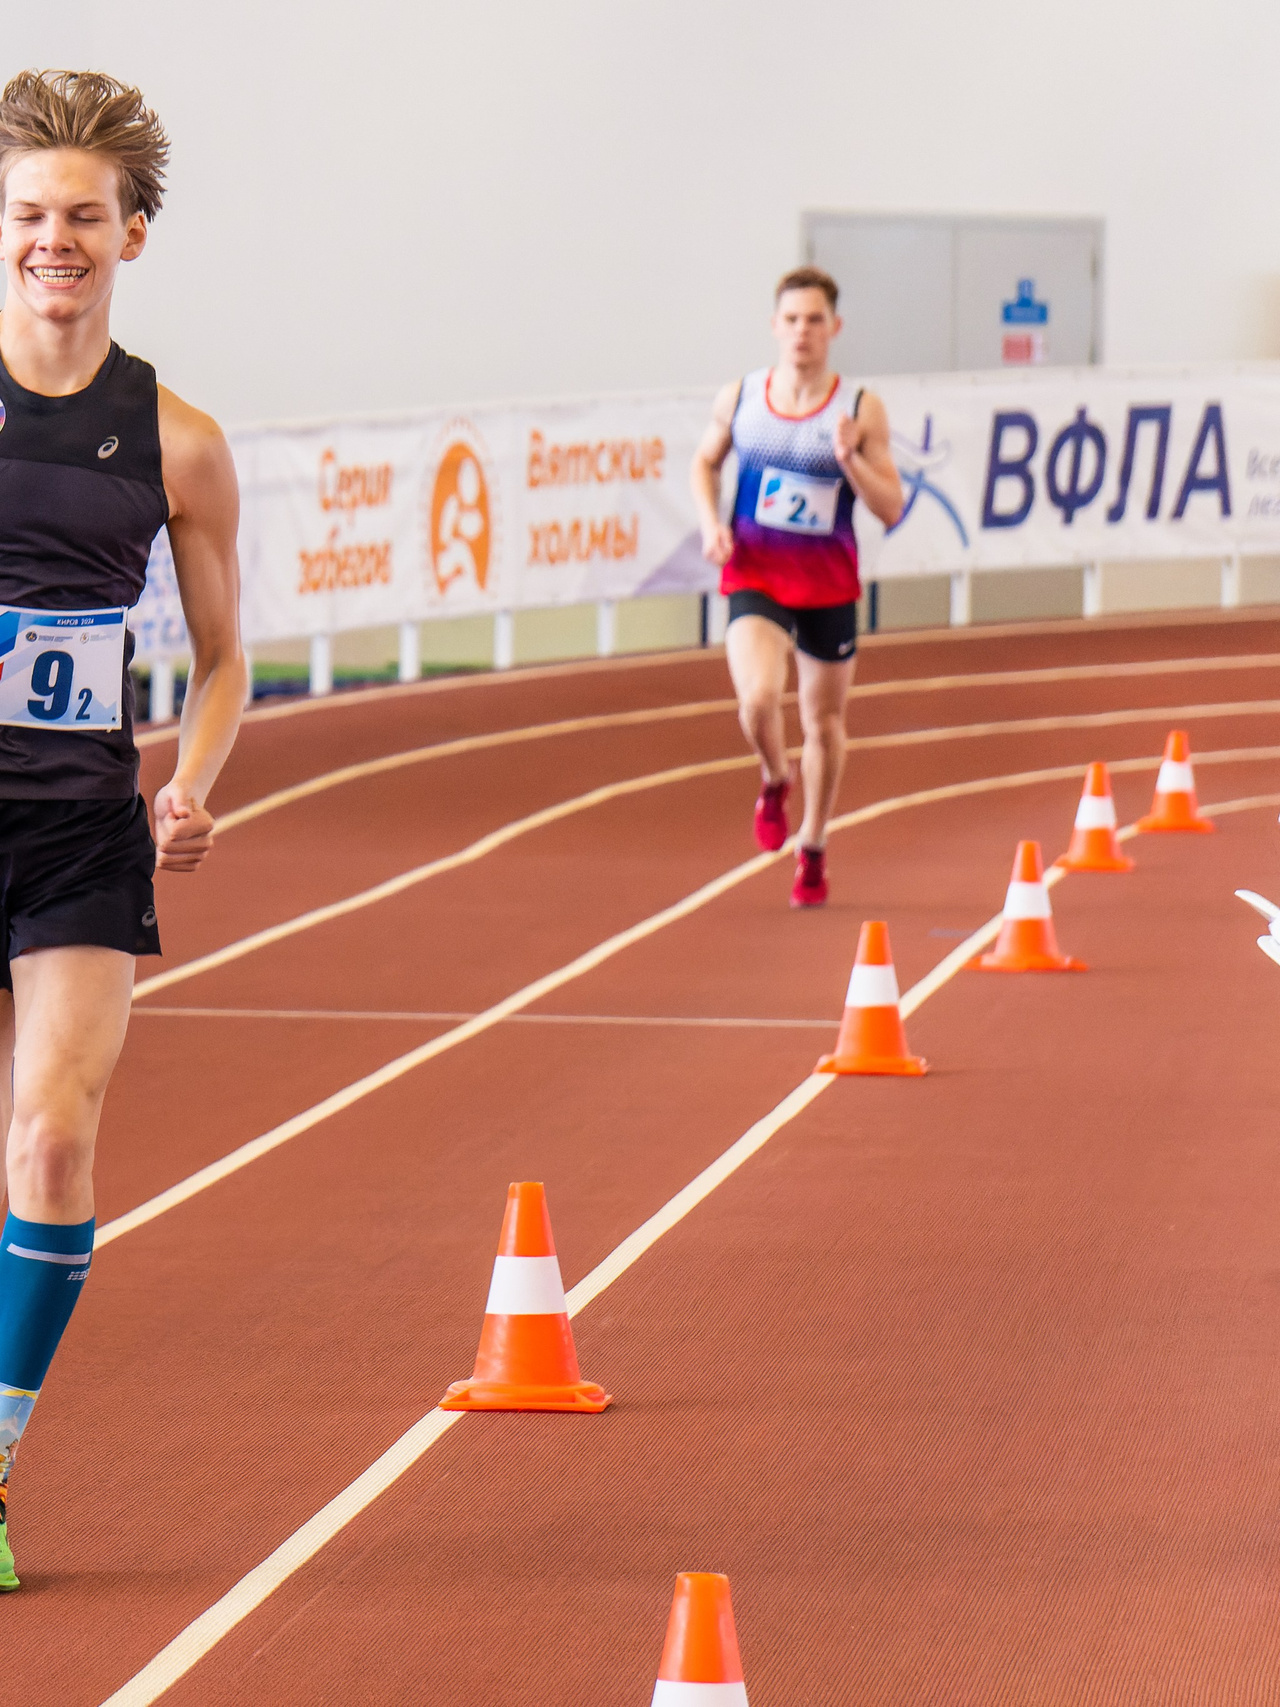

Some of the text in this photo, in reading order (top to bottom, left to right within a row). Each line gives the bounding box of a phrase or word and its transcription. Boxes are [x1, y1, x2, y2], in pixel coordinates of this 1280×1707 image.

[318, 447, 394, 524] Серия
[527, 429, 665, 490] Вятские
[980, 403, 1232, 529] ВФЛА
[528, 513, 639, 566] холмы
[788, 494, 807, 522] 2
[298, 525, 392, 595] забегов
[27, 650, 93, 721] 9 2
